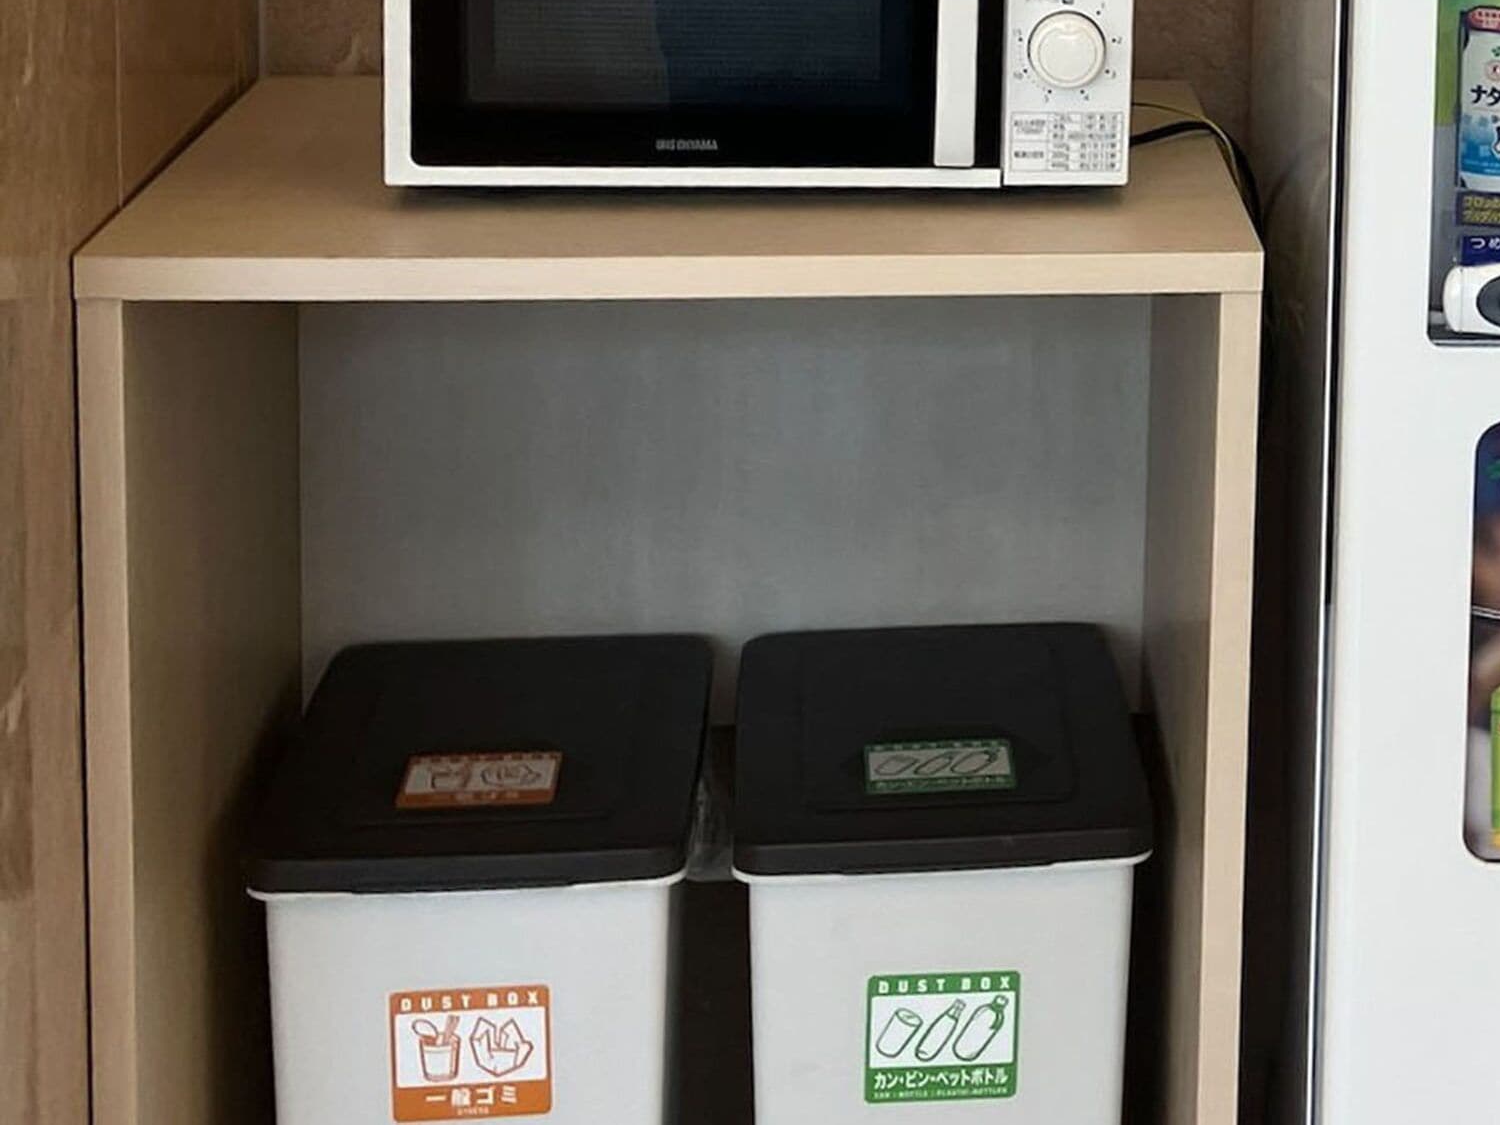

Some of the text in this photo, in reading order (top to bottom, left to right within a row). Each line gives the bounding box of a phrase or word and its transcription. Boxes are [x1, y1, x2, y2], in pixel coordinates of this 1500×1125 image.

[878, 976, 1010, 994] DUST BOX
[401, 990, 538, 1011] DUST BOX
[873, 1068, 1008, 1090] カン・ビン・ペットボトル
[425, 1084, 518, 1108] 一般ゴミ
